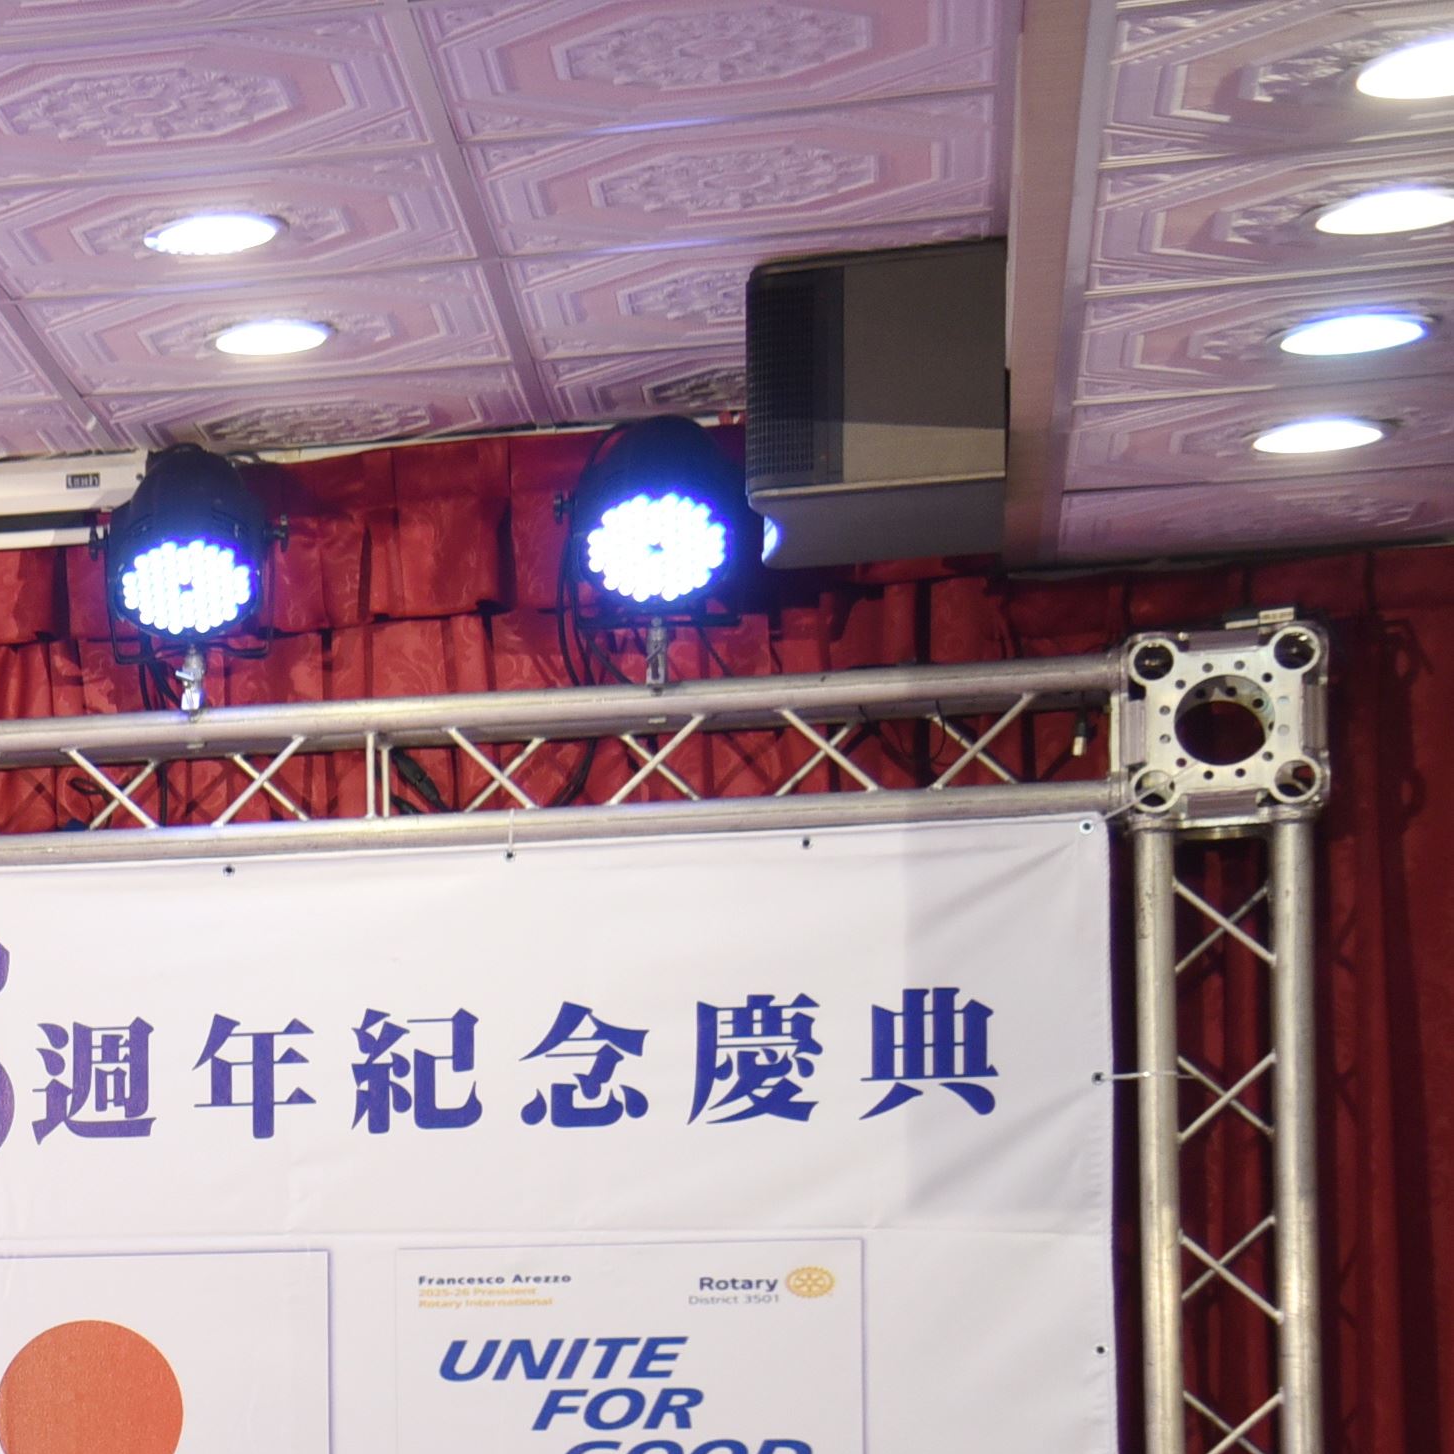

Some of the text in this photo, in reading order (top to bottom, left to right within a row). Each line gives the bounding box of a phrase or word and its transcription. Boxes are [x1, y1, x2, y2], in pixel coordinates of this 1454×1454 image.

[418, 1274, 572, 1286] Francesco Arezzo
[699, 1276, 779, 1293] Rotary
[438, 1335, 689, 1383] UNITE
[531, 1386, 705, 1432] FOR
